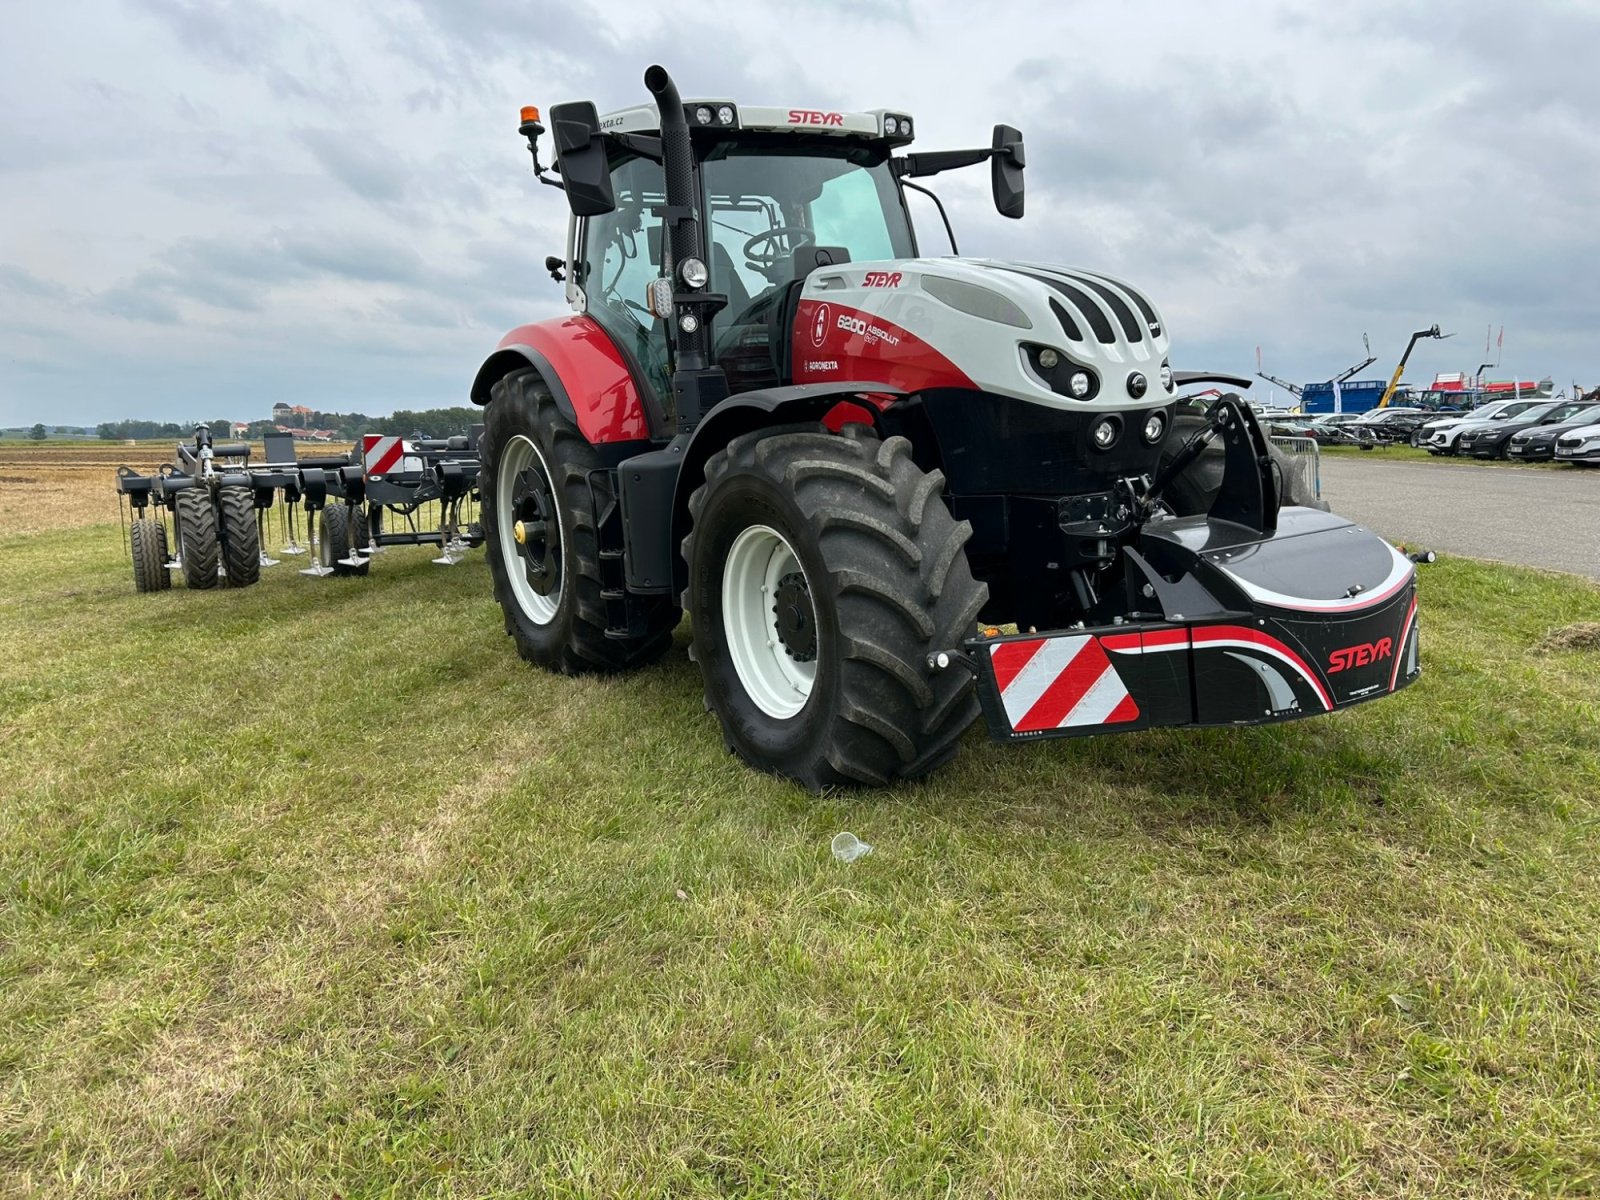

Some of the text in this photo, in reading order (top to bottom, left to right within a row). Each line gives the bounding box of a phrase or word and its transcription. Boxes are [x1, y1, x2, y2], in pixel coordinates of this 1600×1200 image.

[788, 110, 843, 126] STEYR
[861, 272, 902, 288] STEYR
[837, 314, 900, 347] 6200 ABSOLUT
[1327, 637, 1392, 674] STEYR
